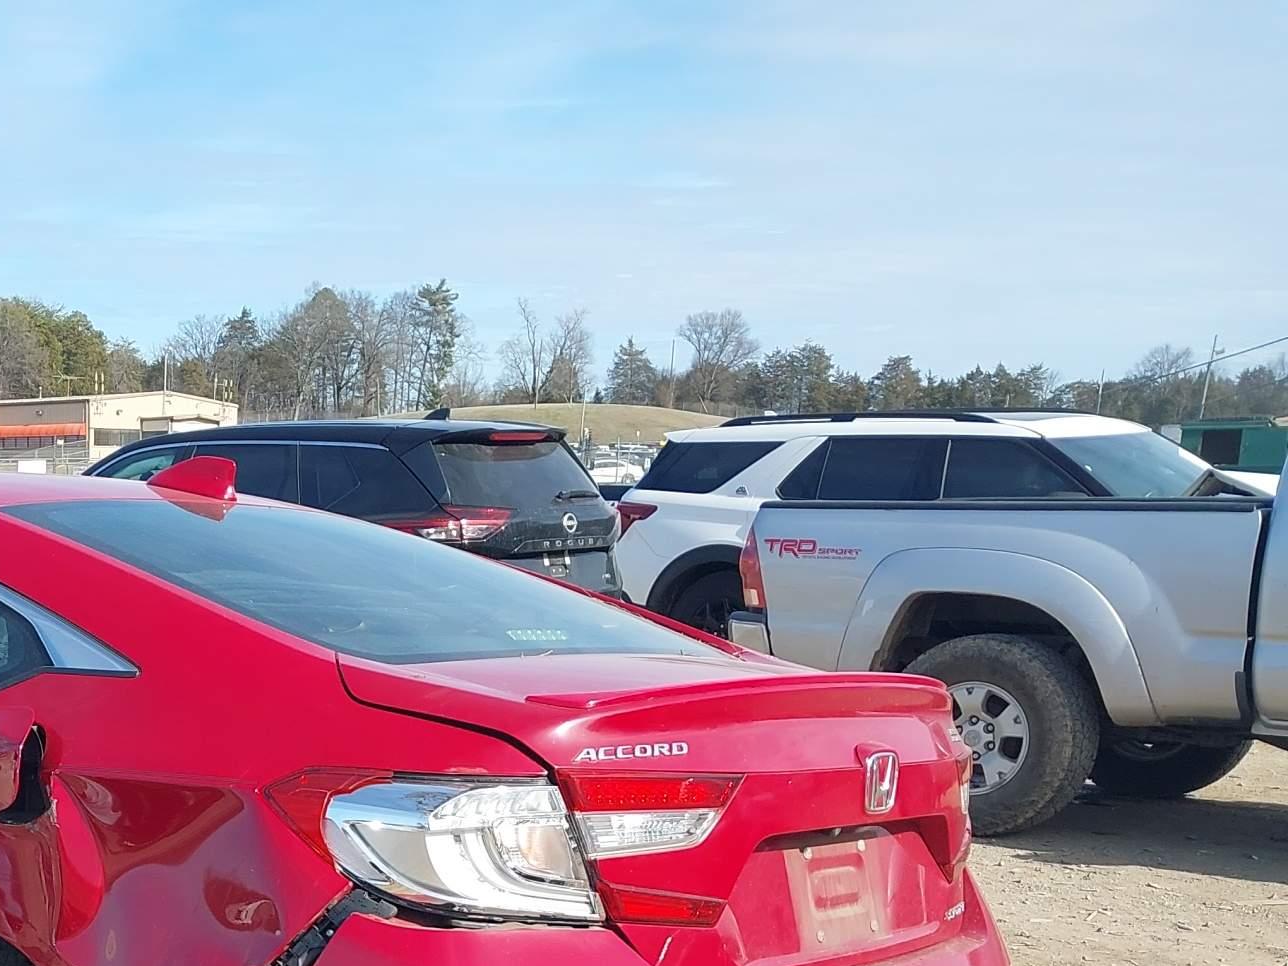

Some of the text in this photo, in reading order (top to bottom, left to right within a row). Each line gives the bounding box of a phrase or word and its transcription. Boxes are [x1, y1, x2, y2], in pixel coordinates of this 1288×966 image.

[764, 538, 862, 559] TRD SPORT
[572, 742, 689, 763] ACCORD
